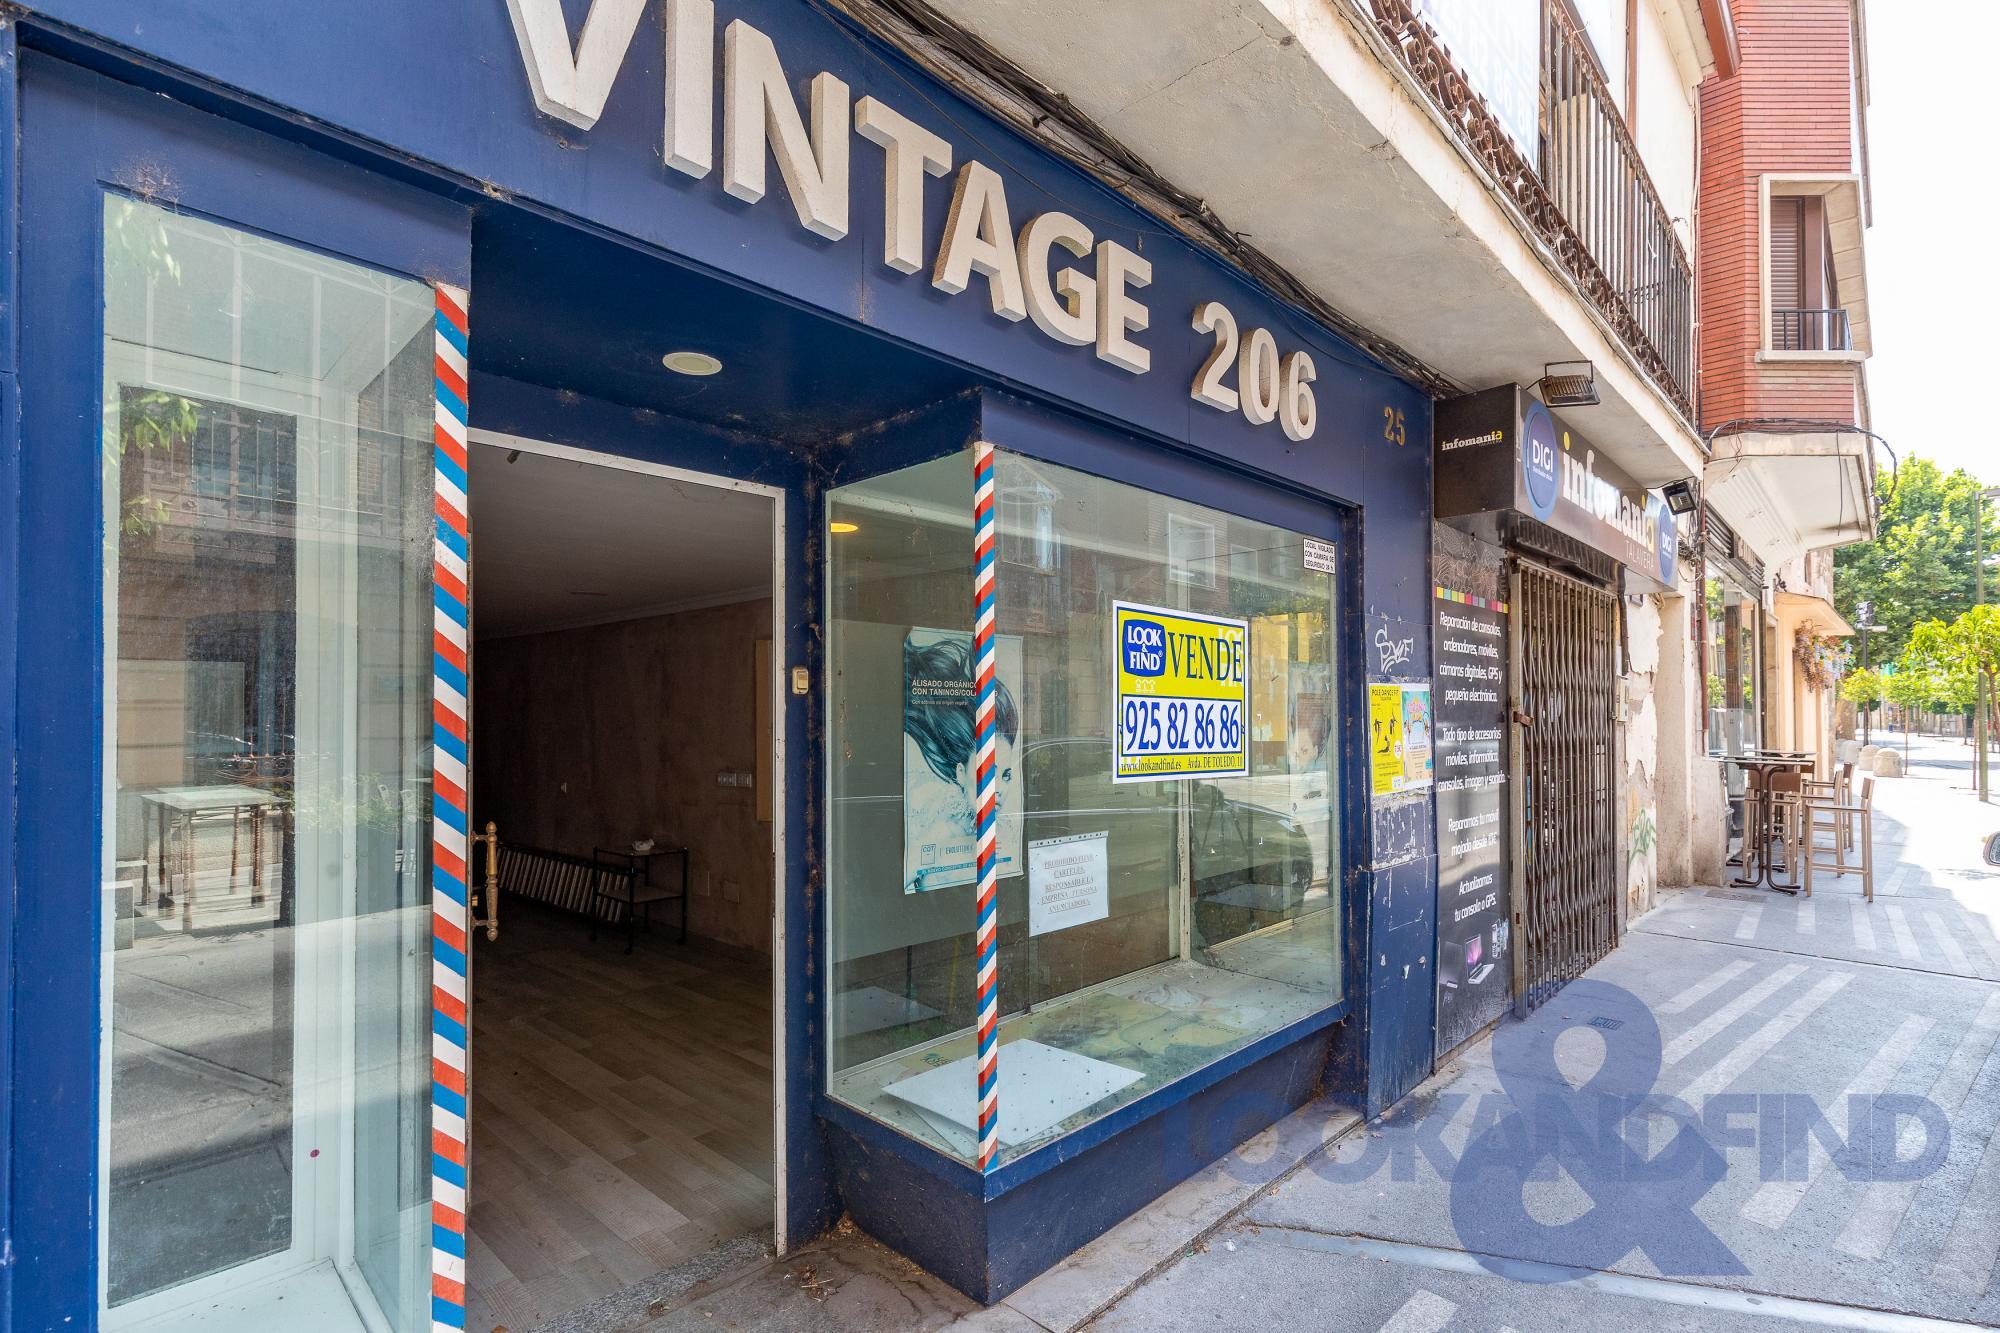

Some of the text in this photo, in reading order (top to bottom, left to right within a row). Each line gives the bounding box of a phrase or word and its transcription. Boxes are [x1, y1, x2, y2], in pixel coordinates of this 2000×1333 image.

[509, 0, 1316, 442] VINTAGE 206
[1383, 406, 1406, 447] 25
[1441, 430, 1503, 451] infomania
[1532, 439, 1553, 472] DIGI
[1305, 541, 1316, 550] LOCAL
[1440, 611, 1501, 637] Reparación de consolas,
[1127, 625, 1162, 647] LOOK
[1141, 643, 1148, 653] &
[1167, 632, 1242, 682] VENDE
[1443, 637, 1498, 659] ordenadores, móviles,
[912, 679, 942, 688] ALISADO
[1440, 661, 1503, 685] cámaras digitales, GPS y
[912, 687, 928, 695] CON
[1444, 688, 1469, 705] pequeña
[1125, 700, 1239, 751] 925 82 86 86
[1442, 726, 1501, 745] Todo tipo de accesorios
[1121, 757, 1182, 772] www.lookandfind.es
[1203, 757, 1211, 768] DE
[1445, 751, 1468, 766] móviles,
[1438, 776, 1464, 792] consolas,
[1465, 776, 1484, 791] imagen
[1484, 776, 1489, 789] y
[1448, 816, 1479, 835] Reparamos
[1480, 813, 1485, 825] tu
[1452, 838, 1471, 858] mojado
[1459, 874, 1493, 896] Actualizamos
[1455, 908, 1461, 922] tu
[1461, 899, 1481, 919] consola
[1481, 900, 1485, 911] o
